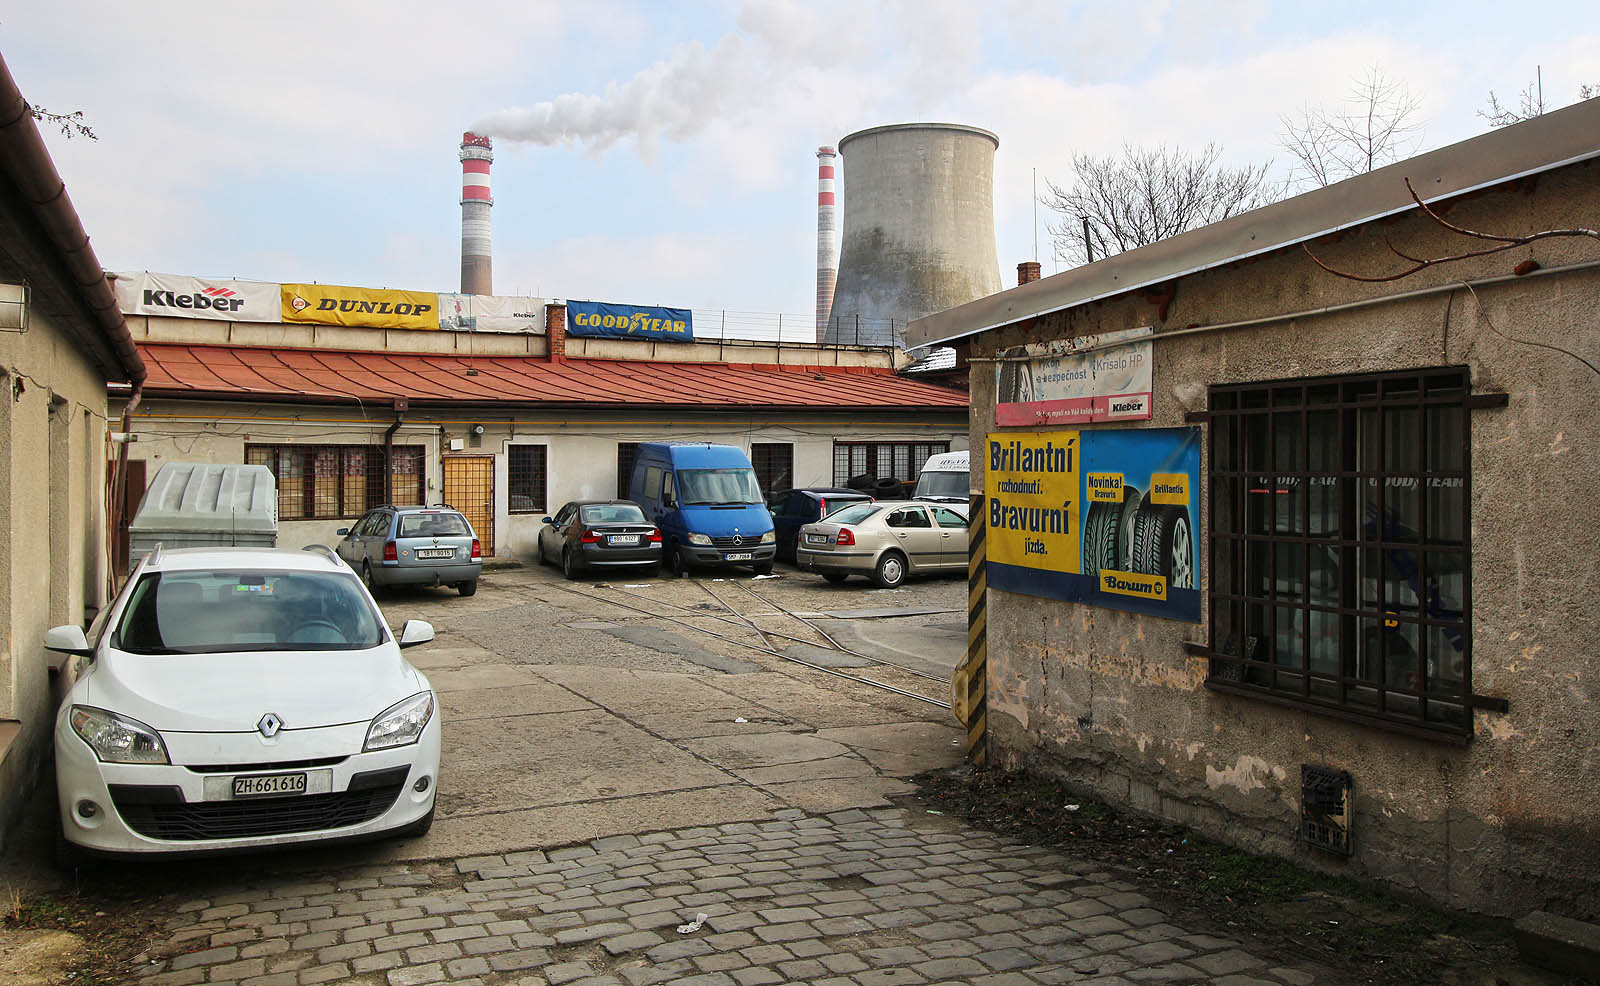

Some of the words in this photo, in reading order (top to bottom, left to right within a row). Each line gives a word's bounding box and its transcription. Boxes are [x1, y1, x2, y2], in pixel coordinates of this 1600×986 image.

[143, 289, 244, 312] Kleber
[316, 298, 432, 317] DUNLOP
[1096, 356, 1127, 372] Krisalp
[1129, 354, 1143, 368] HP
[1043, 369, 1087, 384] bezpečnost
[1112, 402, 1143, 413] Kleber
[990, 438, 1076, 473] Brilantní
[997, 478, 1044, 495] rozhodnutí.
[1088, 475, 1123, 489] Novinka!
[1094, 489, 1117, 499] Bravuris
[990, 497, 1072, 535] Bravurní
[1024, 537, 1049, 556] jízda.
[1103, 576, 1153, 594] Barum
